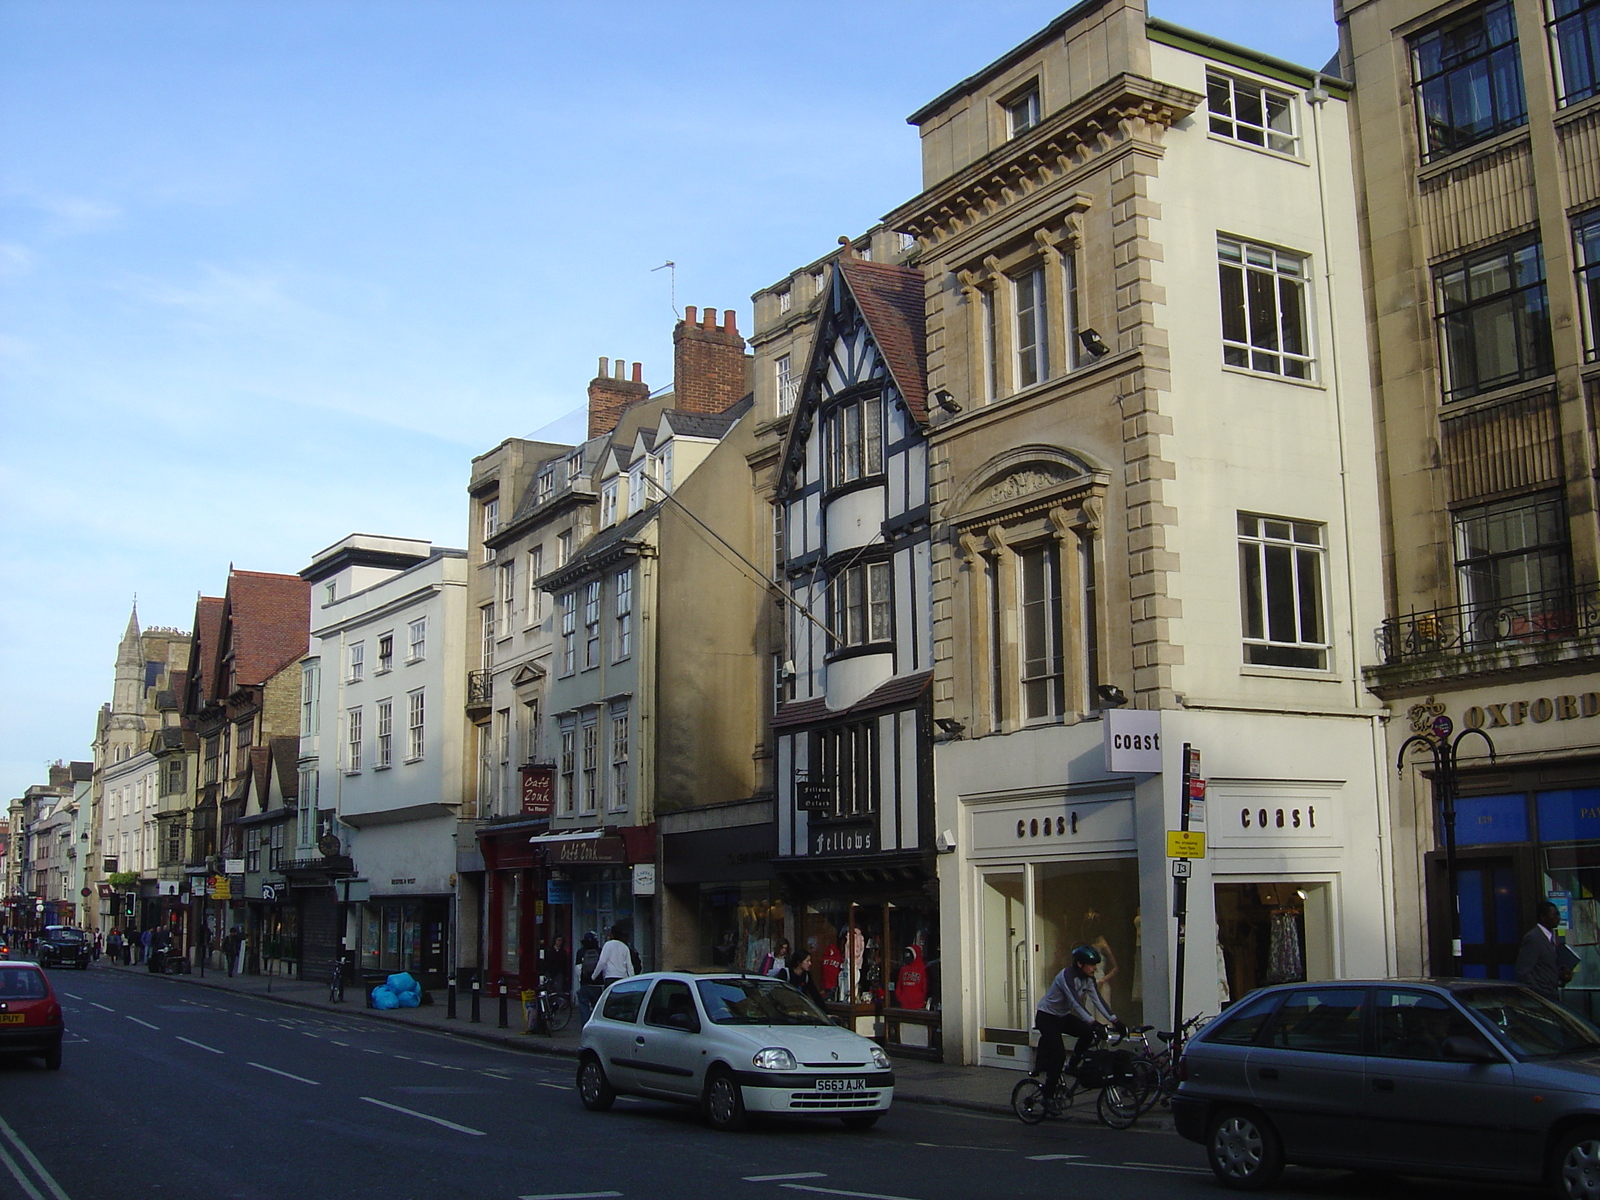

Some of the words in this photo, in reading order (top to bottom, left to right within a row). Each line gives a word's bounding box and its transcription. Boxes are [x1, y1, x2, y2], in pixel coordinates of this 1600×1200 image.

[1464, 692, 1600, 729] OXFORD
[1114, 733, 1160, 750] coast
[525, 777, 550, 788] Café
[525, 789, 549, 801] Zouk
[1017, 811, 1078, 838] coast
[1241, 805, 1316, 829] coast
[815, 831, 871, 855] Fellows
[818, 1080, 844, 1091] S663
[846, 1080, 865, 1090] AJK
